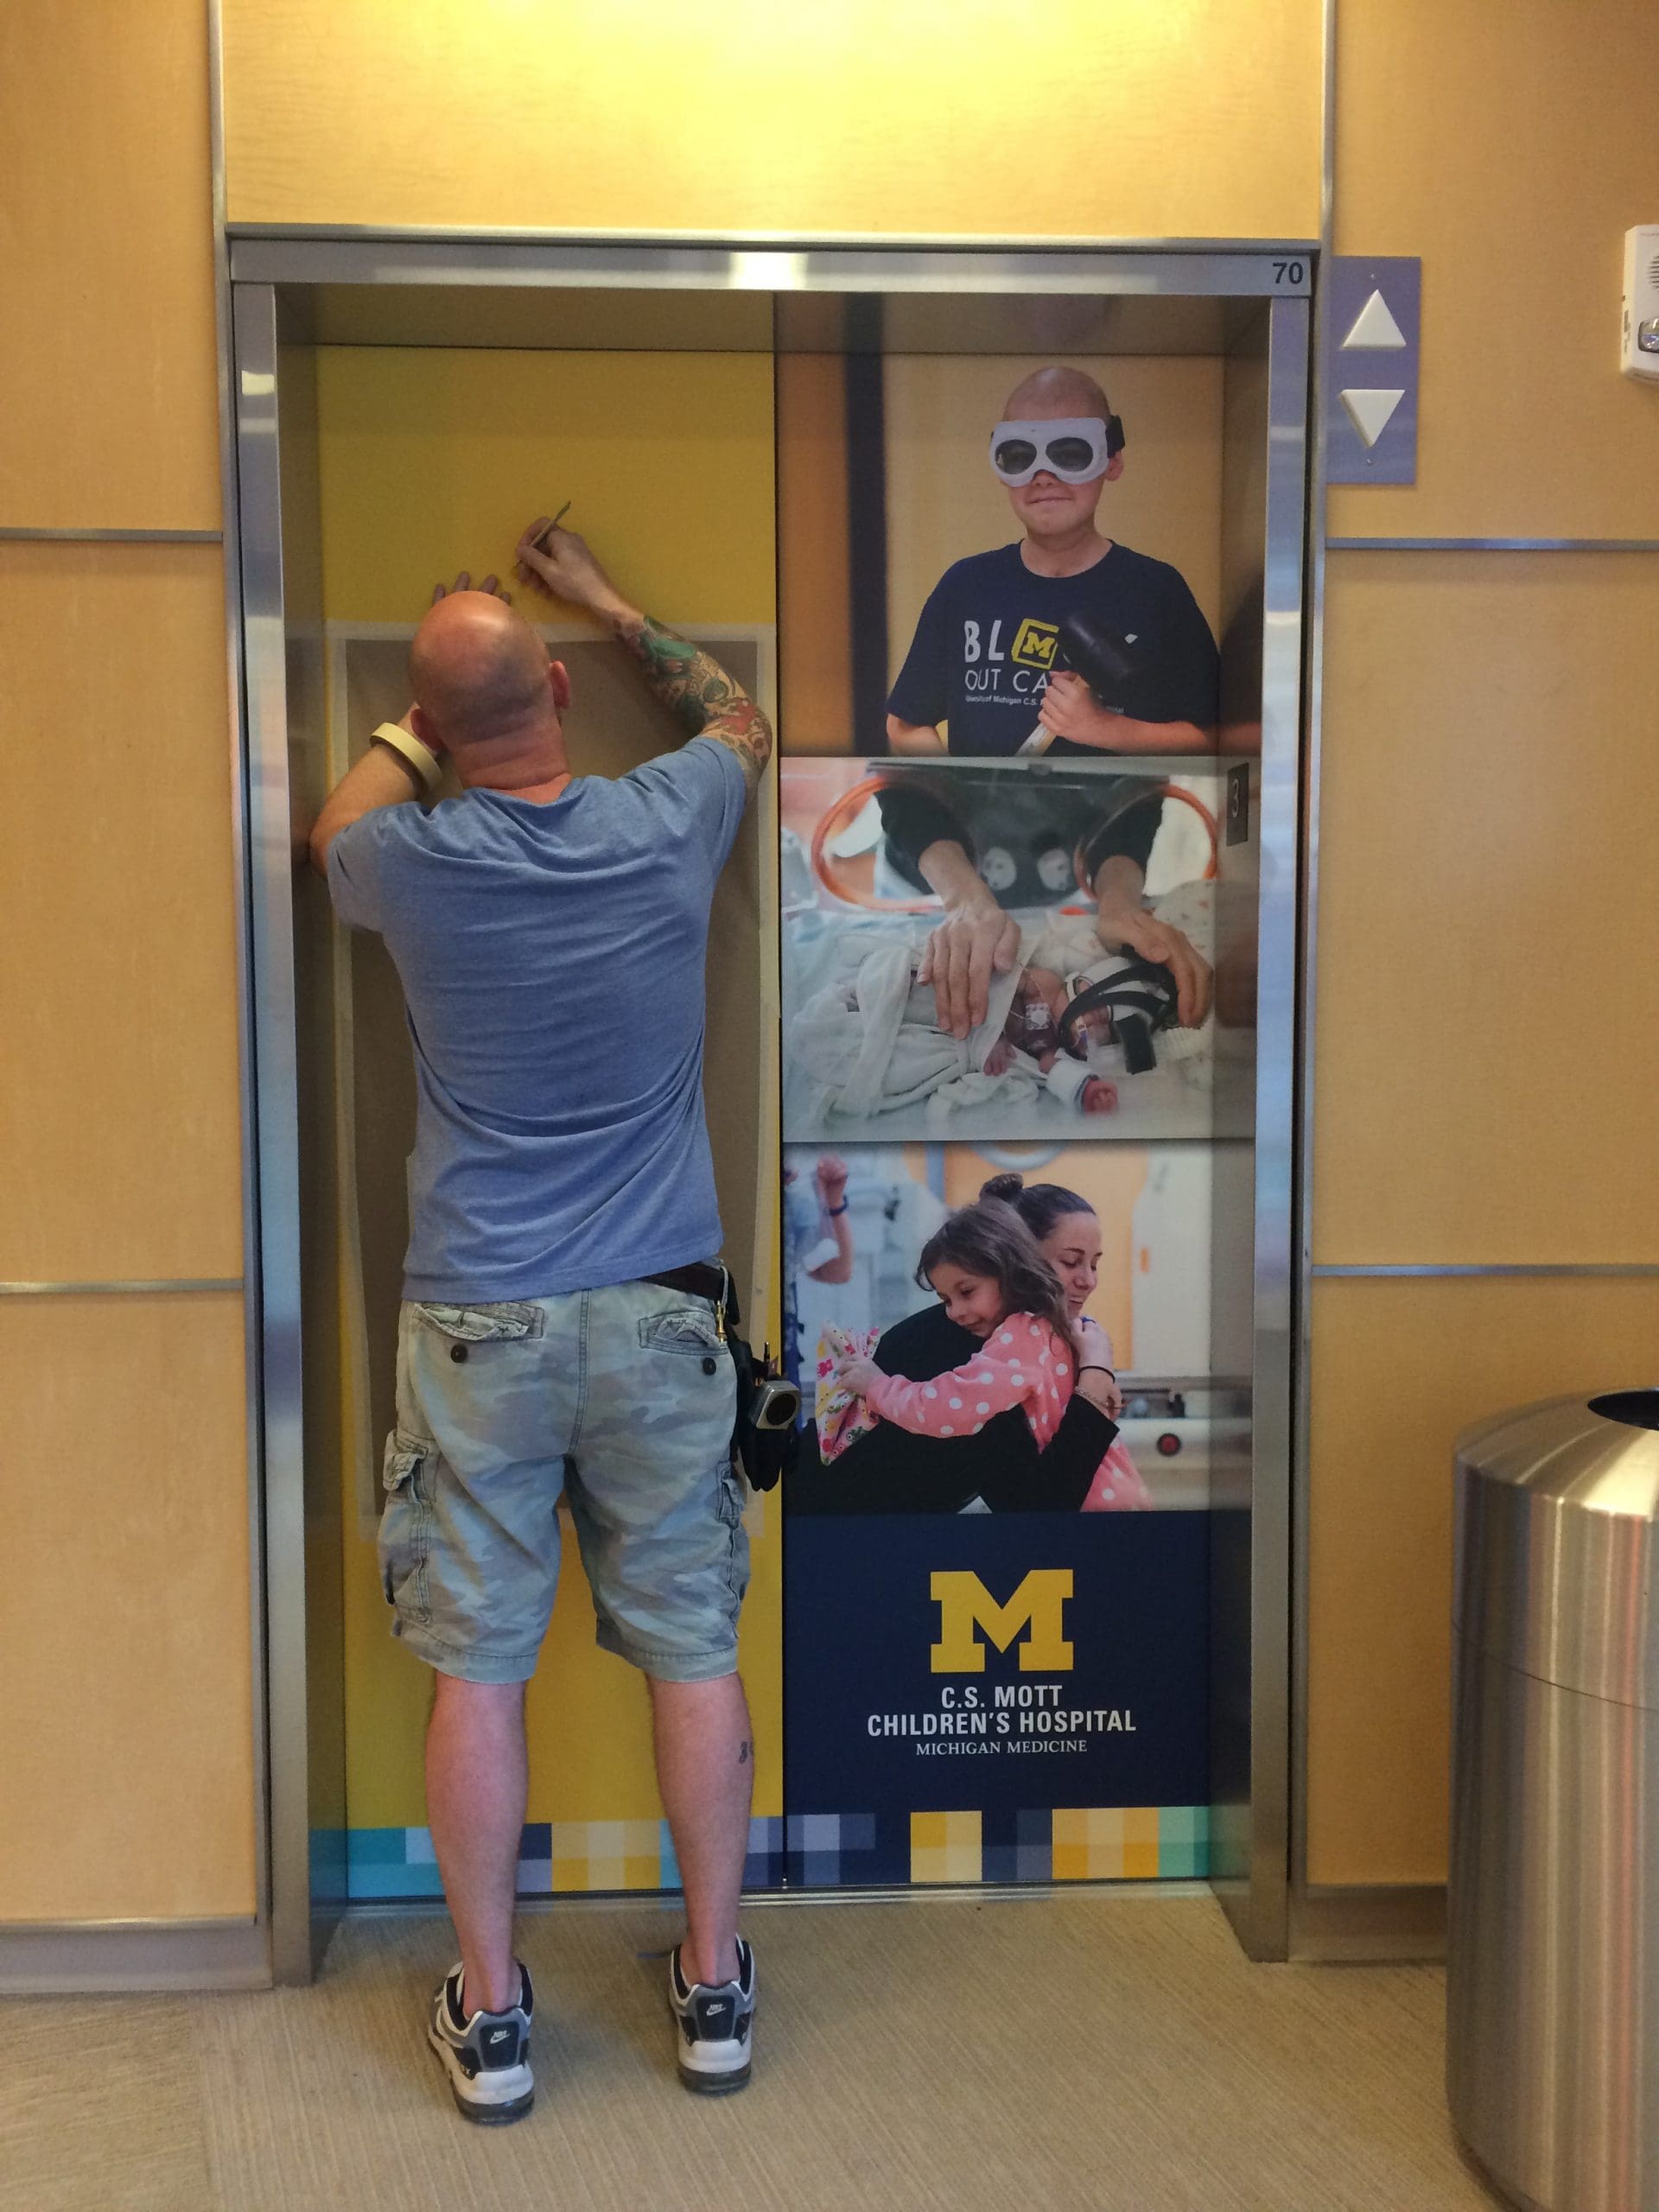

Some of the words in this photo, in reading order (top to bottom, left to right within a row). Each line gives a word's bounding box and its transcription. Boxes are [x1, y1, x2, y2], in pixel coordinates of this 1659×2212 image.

[1273, 262, 1304, 285] 70
[964, 668, 1001, 691] OUT
[1012, 670, 1050, 694] CA
[1231, 778, 1239, 818] 3
[930, 1568, 1074, 1674] M
[941, 1686, 985, 1709] C.S.
[995, 1685, 1063, 1707] MOTT
[867, 1711, 1010, 1737] CHILDREN'S
[1020, 1709, 1136, 1733] HOSPITAL
[915, 1741, 1001, 1756] MICHIGAN
[1007, 1739, 1087, 1754] MEDICINE
